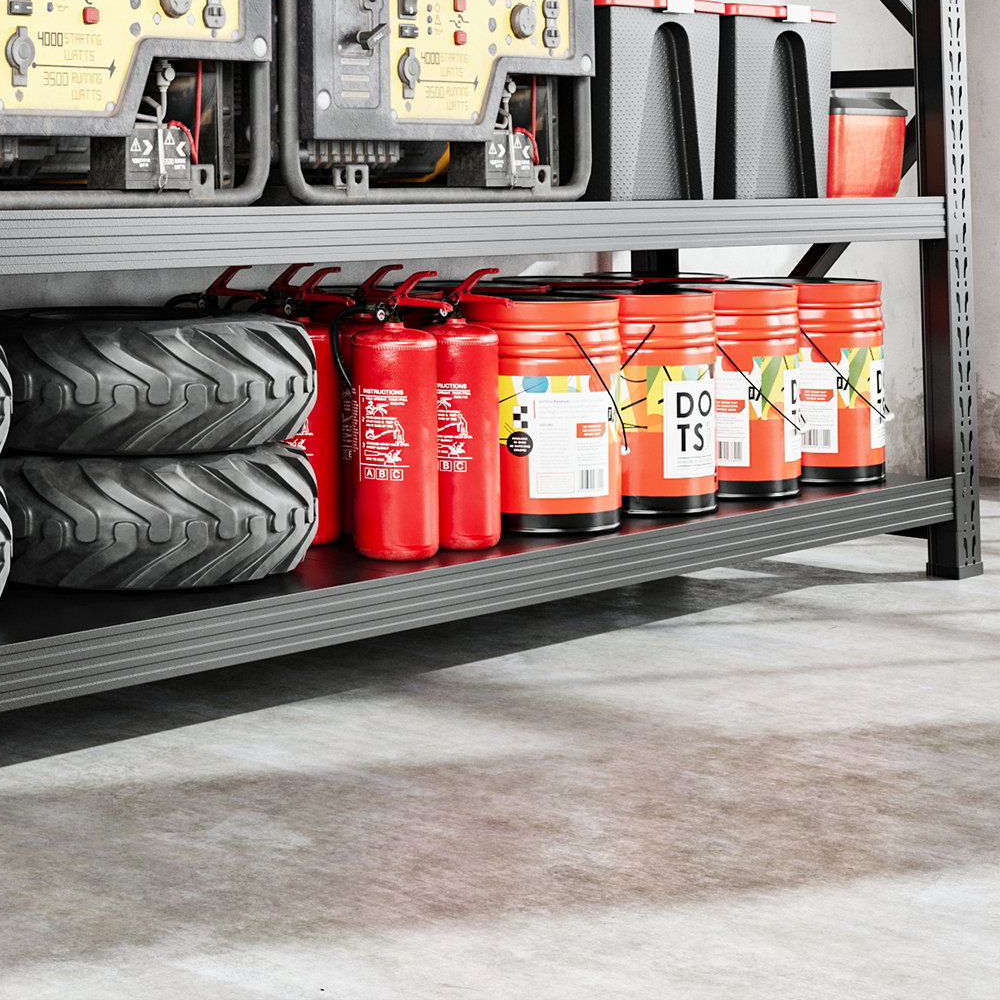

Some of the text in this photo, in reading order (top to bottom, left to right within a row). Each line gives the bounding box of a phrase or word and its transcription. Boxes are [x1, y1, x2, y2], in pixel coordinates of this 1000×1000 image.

[37, 31, 64, 47] 4000
[64, 49, 95, 62] WATTS
[43, 71, 69, 87] 3500
[71, 88, 102, 101] WATTS
[362, 388, 405, 396] INSTRUCTIONS
[676, 390, 712, 418] DO
[677, 423, 704, 451] TS
[442, 461, 464, 470] B C
[366, 469, 400, 479] A B C
